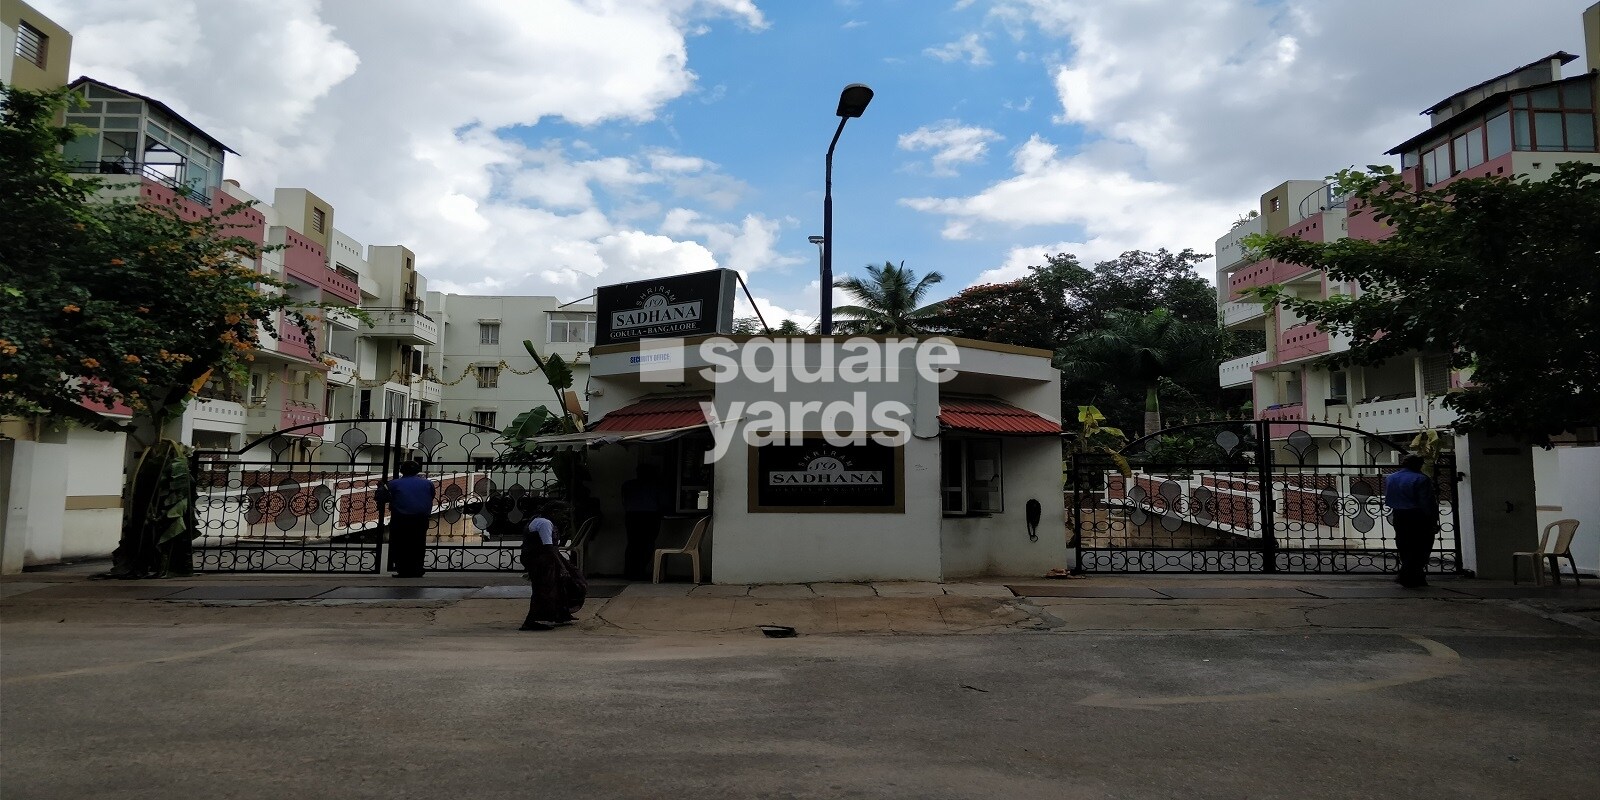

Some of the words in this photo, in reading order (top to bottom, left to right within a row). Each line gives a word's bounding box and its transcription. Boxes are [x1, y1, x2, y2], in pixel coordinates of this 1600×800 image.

[636, 286, 677, 306] SHRIRAM
[616, 306, 697, 327] SADHANA
[798, 451, 854, 467] SHRIRAM
[772, 473, 879, 483] SADHANA
